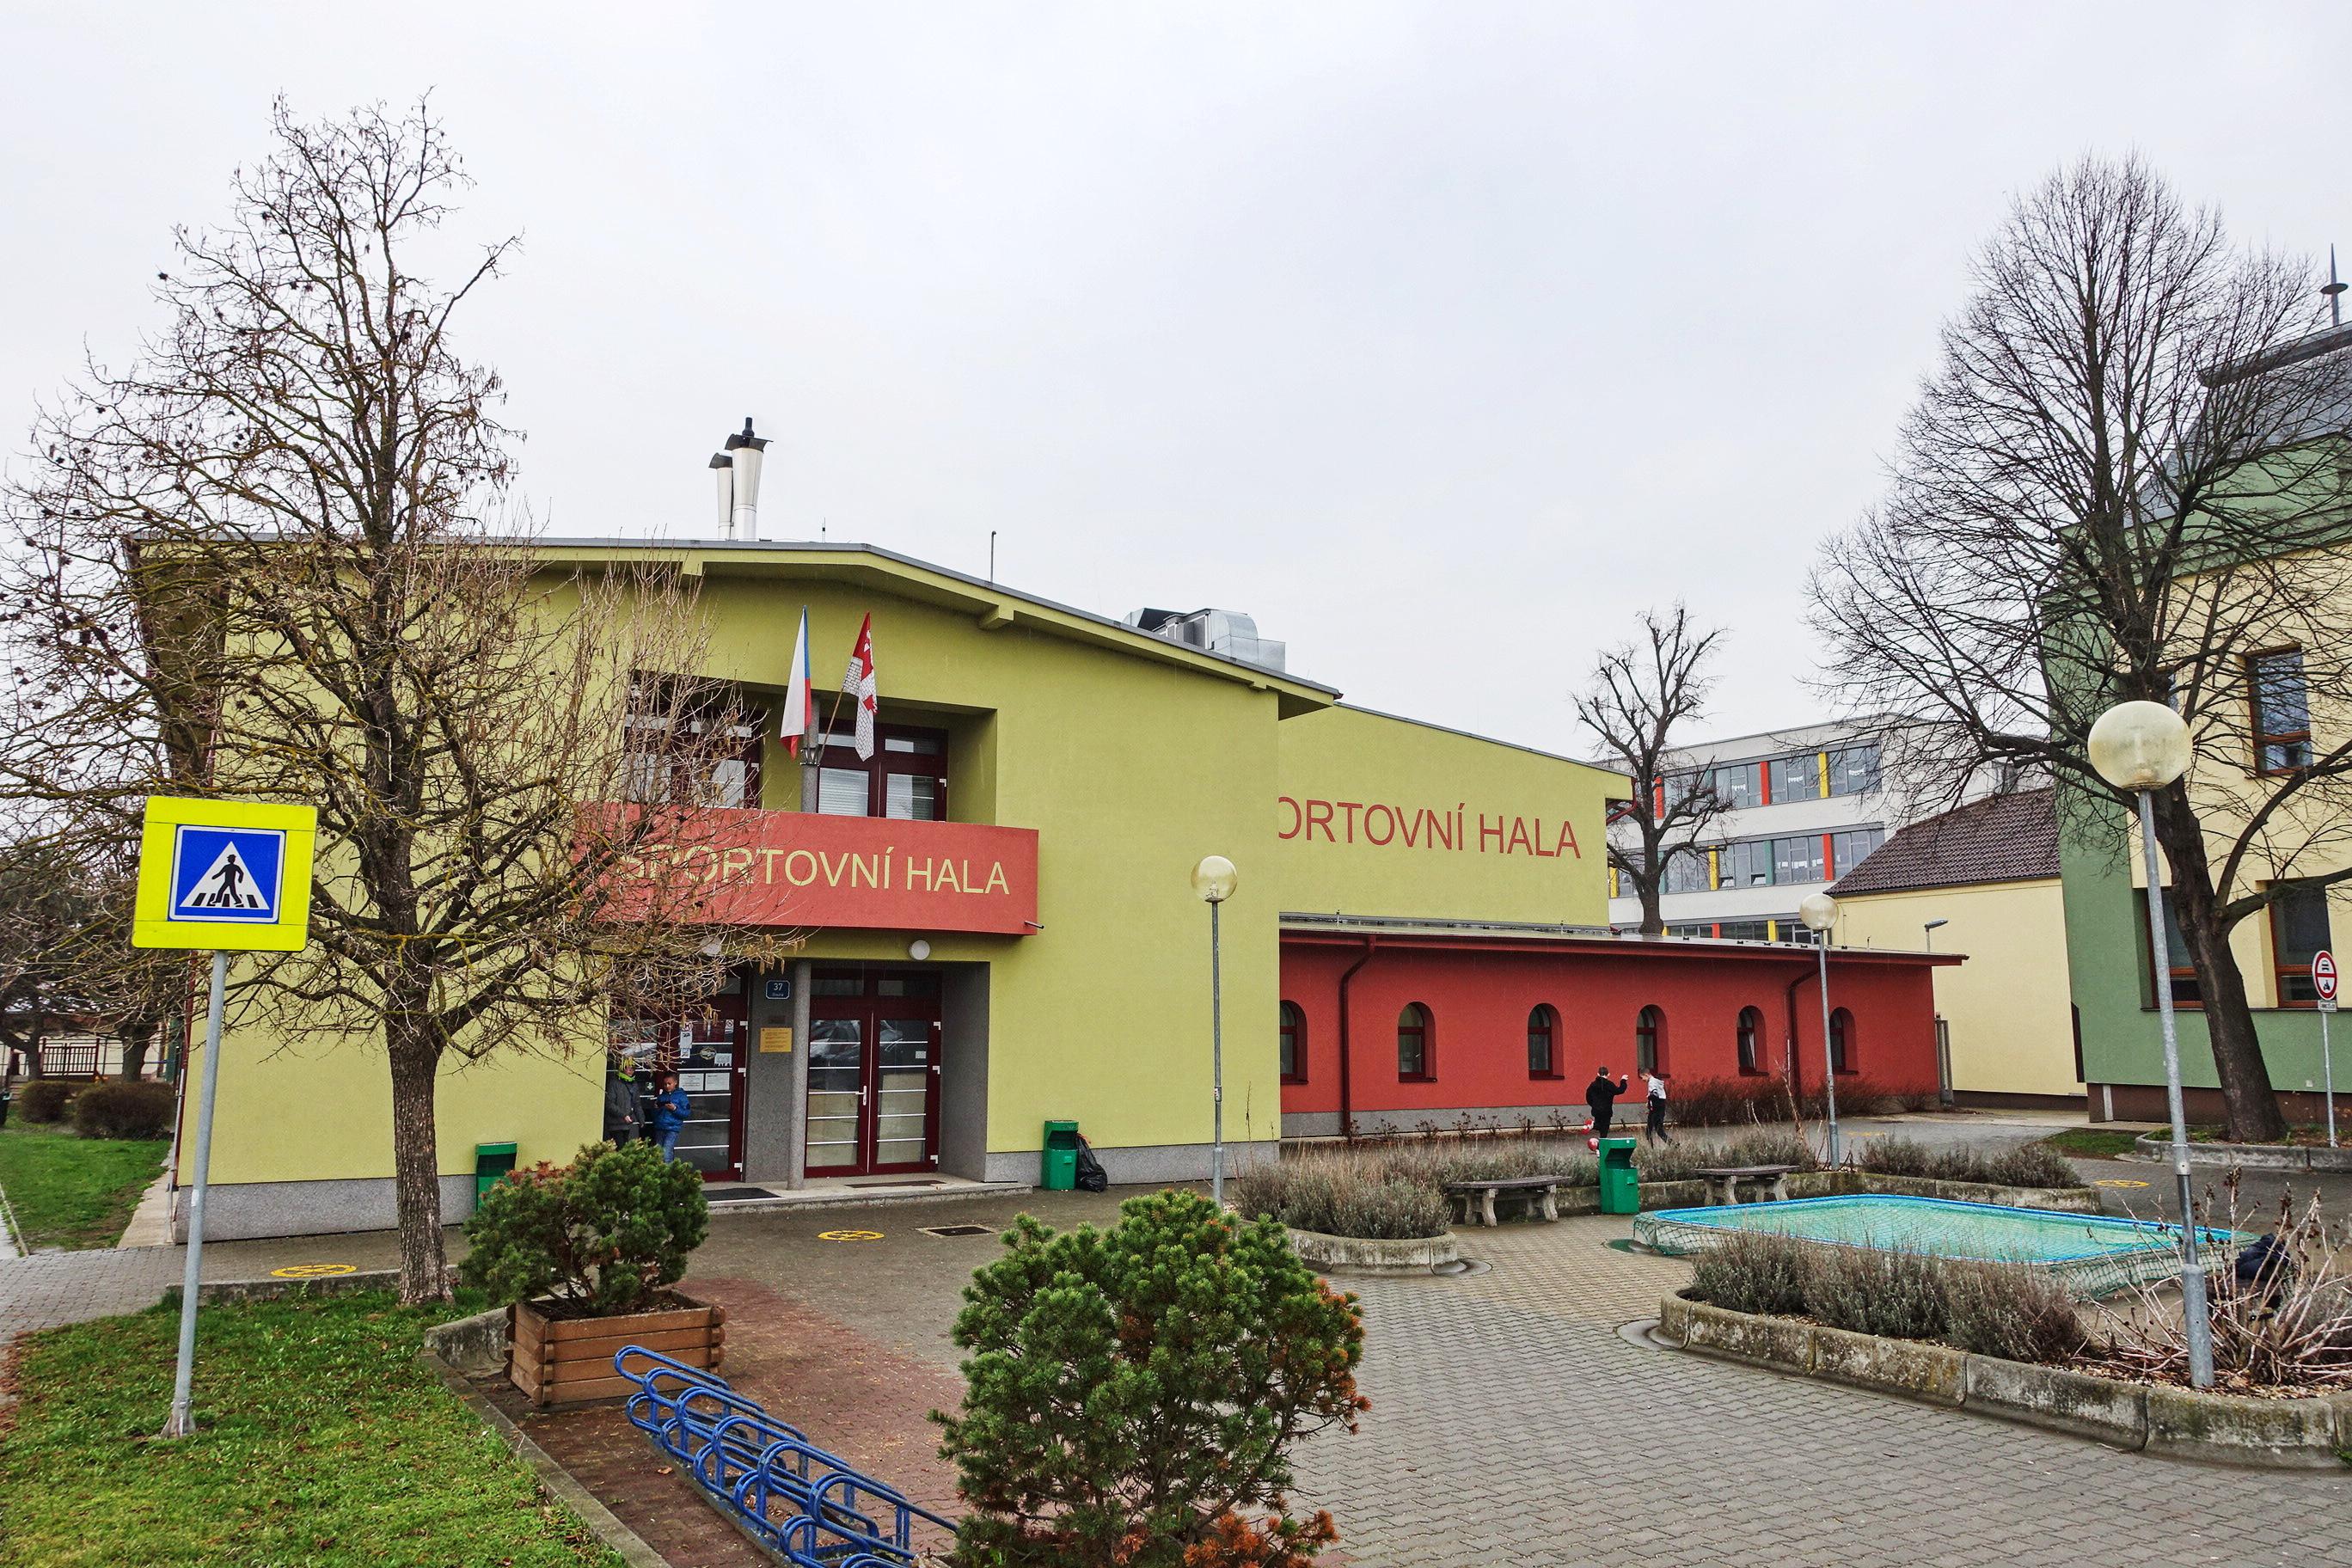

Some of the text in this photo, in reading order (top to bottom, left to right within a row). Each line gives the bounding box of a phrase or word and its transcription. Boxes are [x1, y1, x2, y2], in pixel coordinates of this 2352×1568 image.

[1479, 812, 1582, 859] HALA
[906, 856, 1010, 895] HALA
[773, 983, 783, 991] 37
